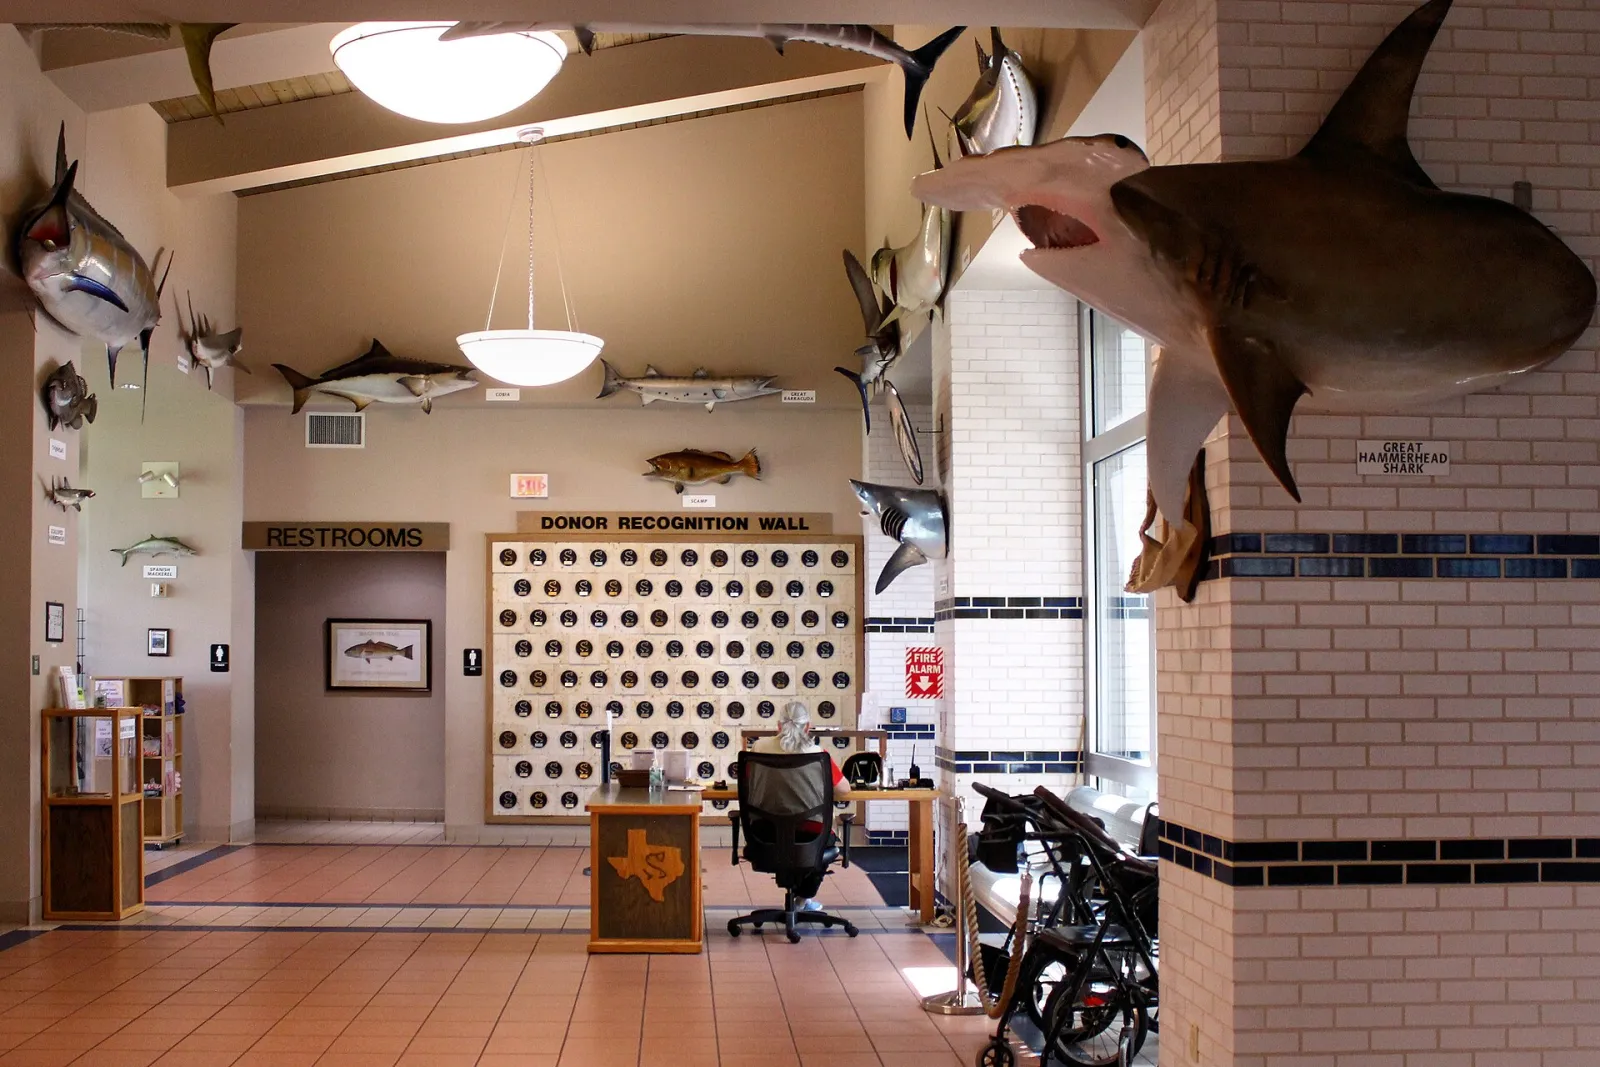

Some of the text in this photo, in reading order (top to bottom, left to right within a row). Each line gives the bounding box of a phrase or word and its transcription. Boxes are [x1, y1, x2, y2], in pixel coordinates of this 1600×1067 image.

[1383, 442, 1423, 453] GREAT
[1359, 452, 1448, 463] HAMMERHEAD
[1383, 463, 1424, 473] SHARK
[517, 476, 542, 495] EXIT
[541, 516, 809, 531] DONOR RECOGNITION WALL
[267, 527, 423, 547] RESTROOMS
[914, 653, 937, 663] FIRE
[909, 664, 941, 674] ALARM
